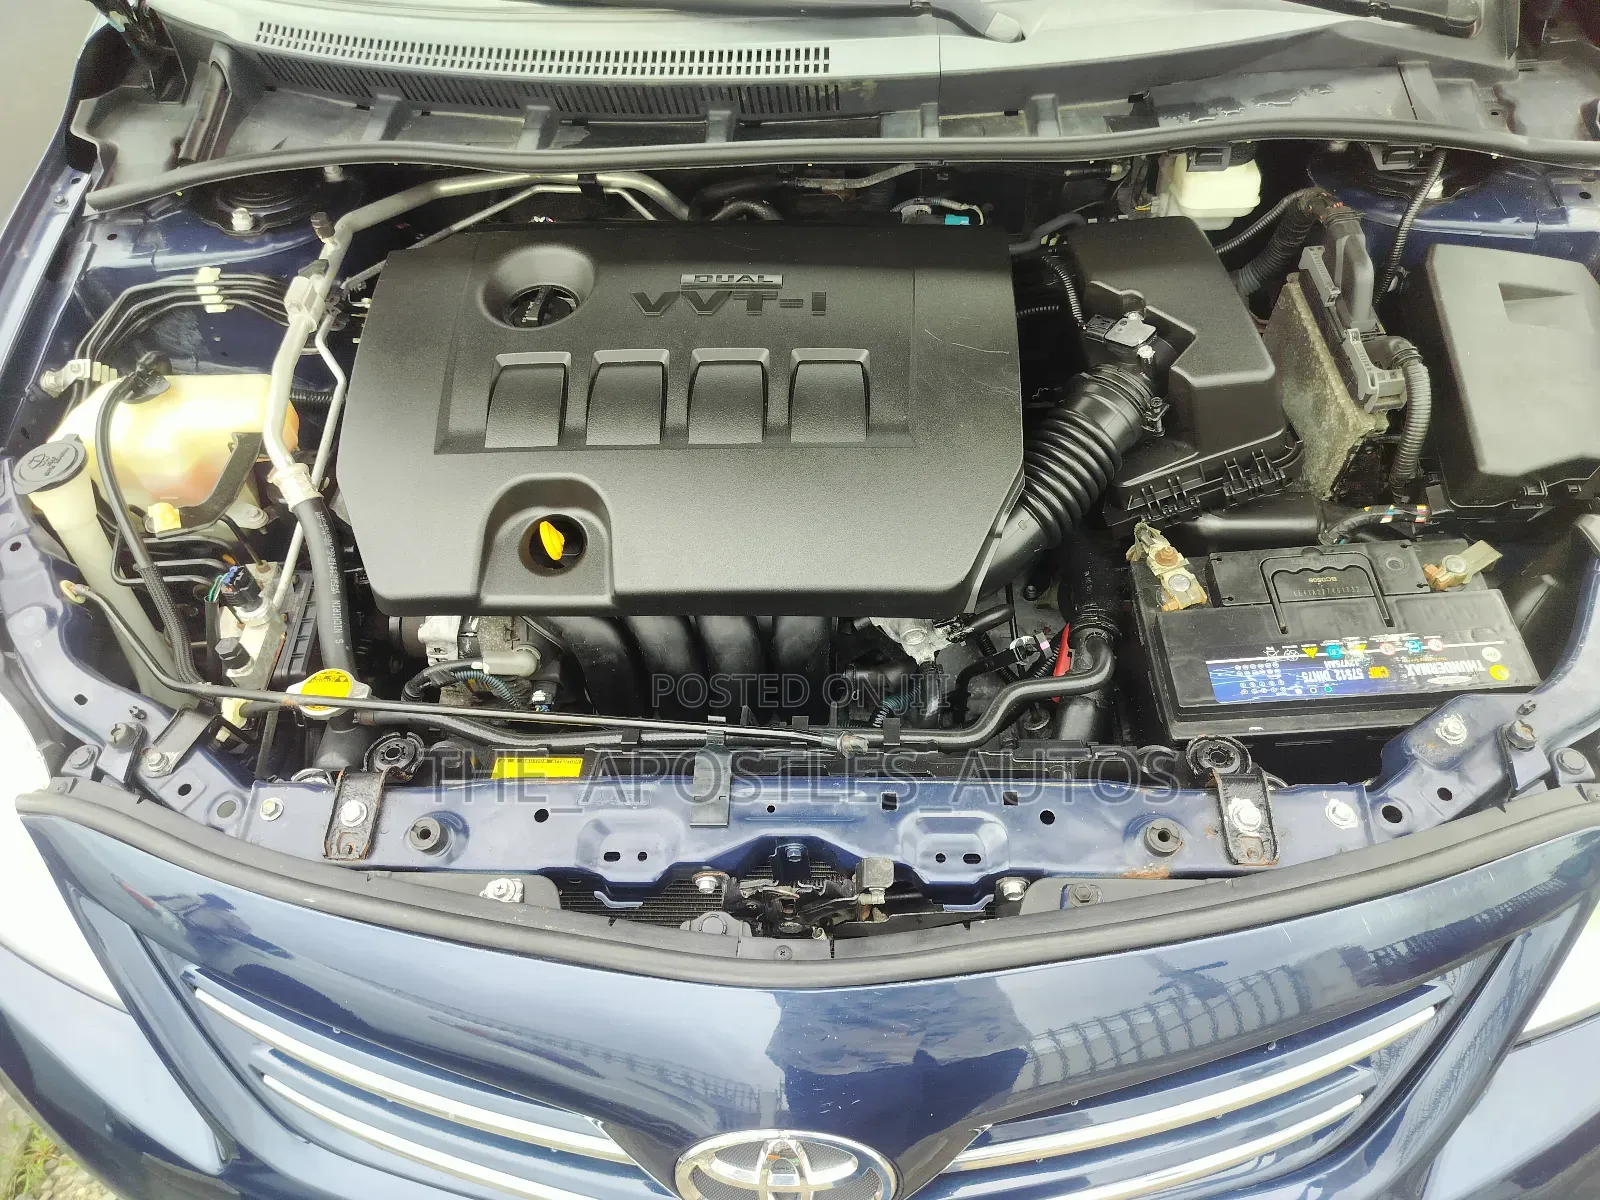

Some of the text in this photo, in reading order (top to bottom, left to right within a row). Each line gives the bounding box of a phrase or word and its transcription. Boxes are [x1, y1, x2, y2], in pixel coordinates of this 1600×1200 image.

[693, 273, 775, 284] DUAL
[1368, 665, 1390, 679] CMF
[1404, 659, 1486, 677] THUNDERMAX
[1301, 669, 1332, 683] DIN75
